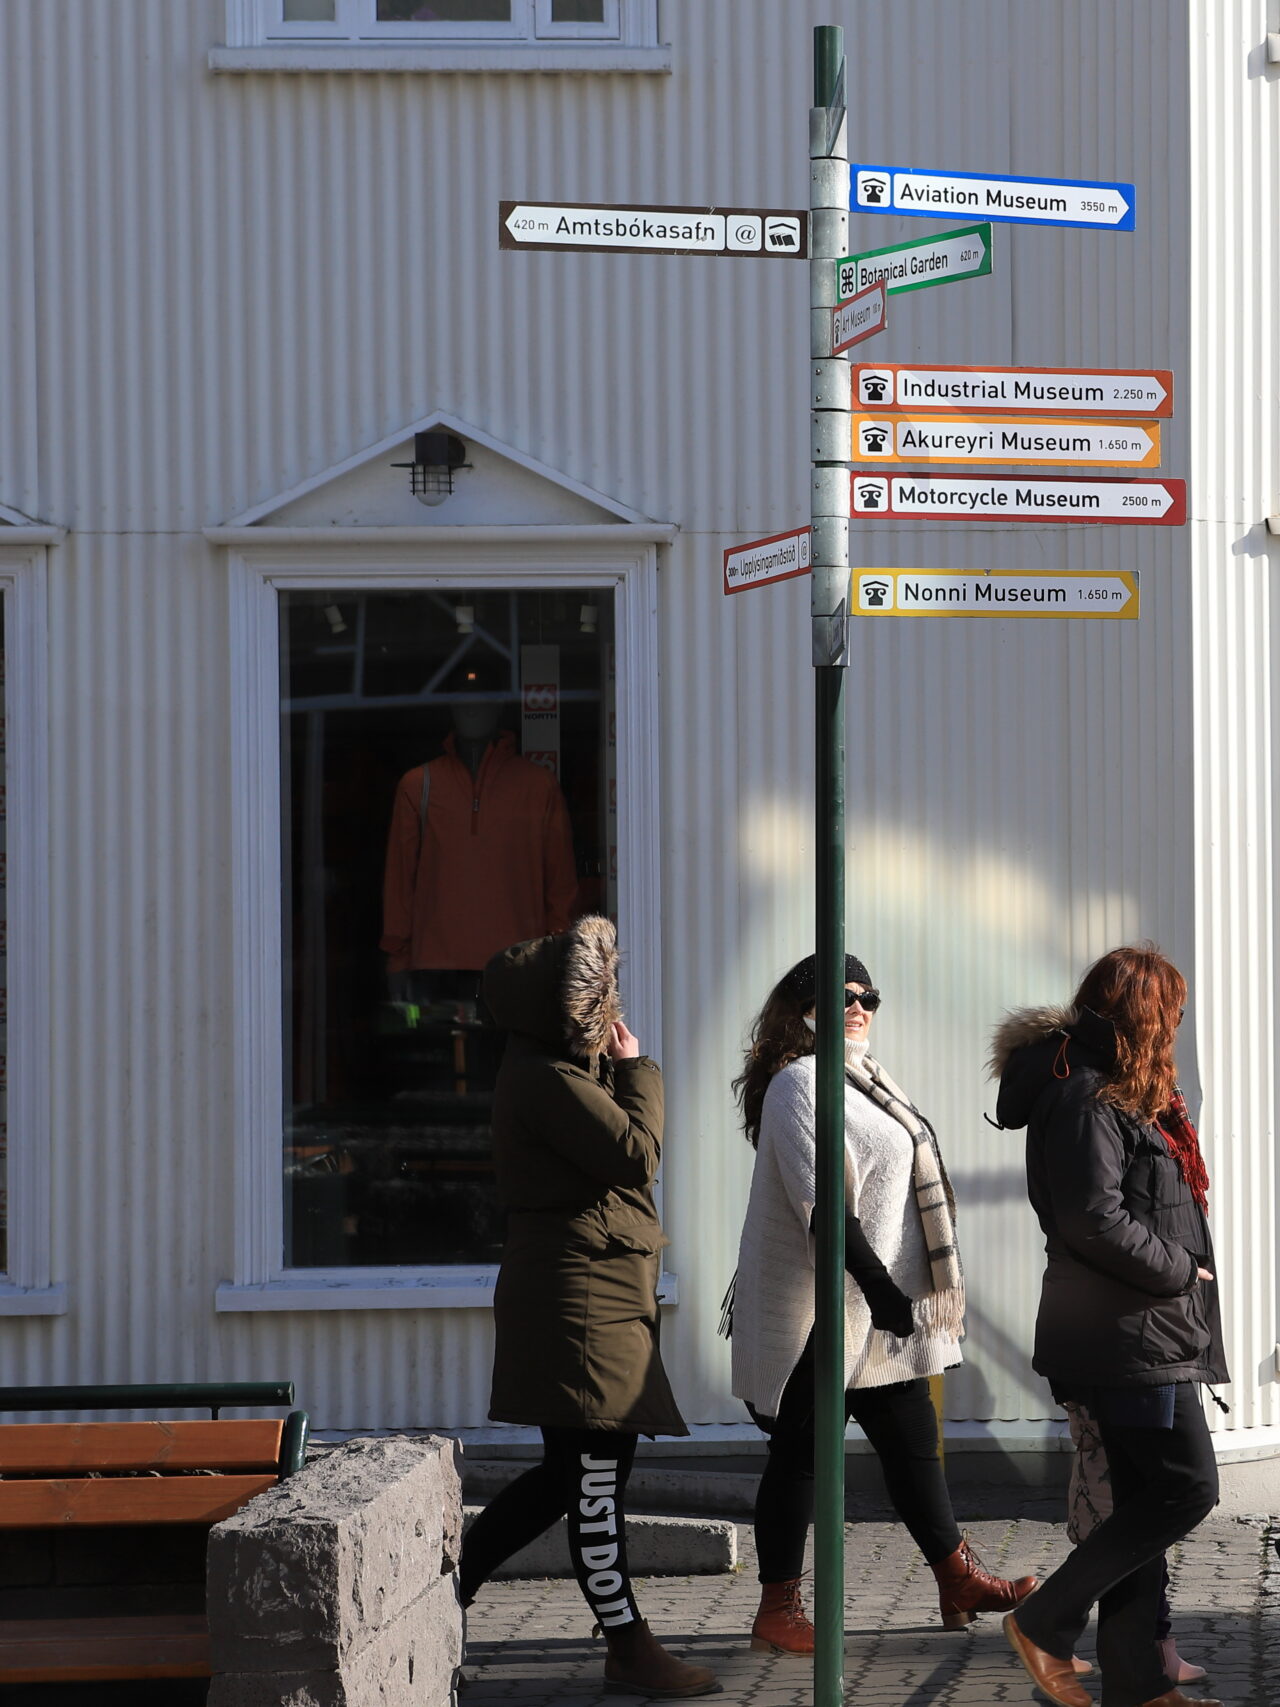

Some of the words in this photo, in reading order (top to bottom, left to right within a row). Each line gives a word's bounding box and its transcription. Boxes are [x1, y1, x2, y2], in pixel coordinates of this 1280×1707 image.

[900, 183, 979, 206] Aviation
[986, 189, 1067, 212] Museum
[1080, 201, 1105, 212] 3550
[1108, 204, 1118, 213] m
[513, 219, 535, 231] 420
[538, 222, 549, 231] m
[555, 216, 716, 241] Amtsbókasafn
[860, 258, 908, 286] Botanical
[910, 252, 948, 275] Garden
[960, 250, 971, 262] 620
[972, 250, 979, 259] m
[903, 378, 1007, 400] Industrial
[1014, 381, 1104, 402] Museum
[1113, 388, 1144, 400] 2.250
[1147, 391, 1157, 400] m
[902, 430, 993, 453] Akureyri
[1001, 432, 1091, 452] Museum
[1099, 439, 1128, 450] 1.650
[1132, 441, 1142, 450] m
[898, 486, 1008, 508] Motorcycle
[1015, 489, 1100, 508] Museum
[1122, 496, 1148, 507] 2500
[1151, 498, 1161, 507] m
[904, 583, 967, 602] Nonni
[975, 584, 1067, 603] Museum
[1078, 589, 1107, 601] 1.650
[1112, 591, 1122, 600] m
[524, 712, 558, 720] NORTH
[579, 1453, 618, 1536] JUST
[580, 1542, 623, 1597] DO
[595, 1596, 635, 1628] IT
